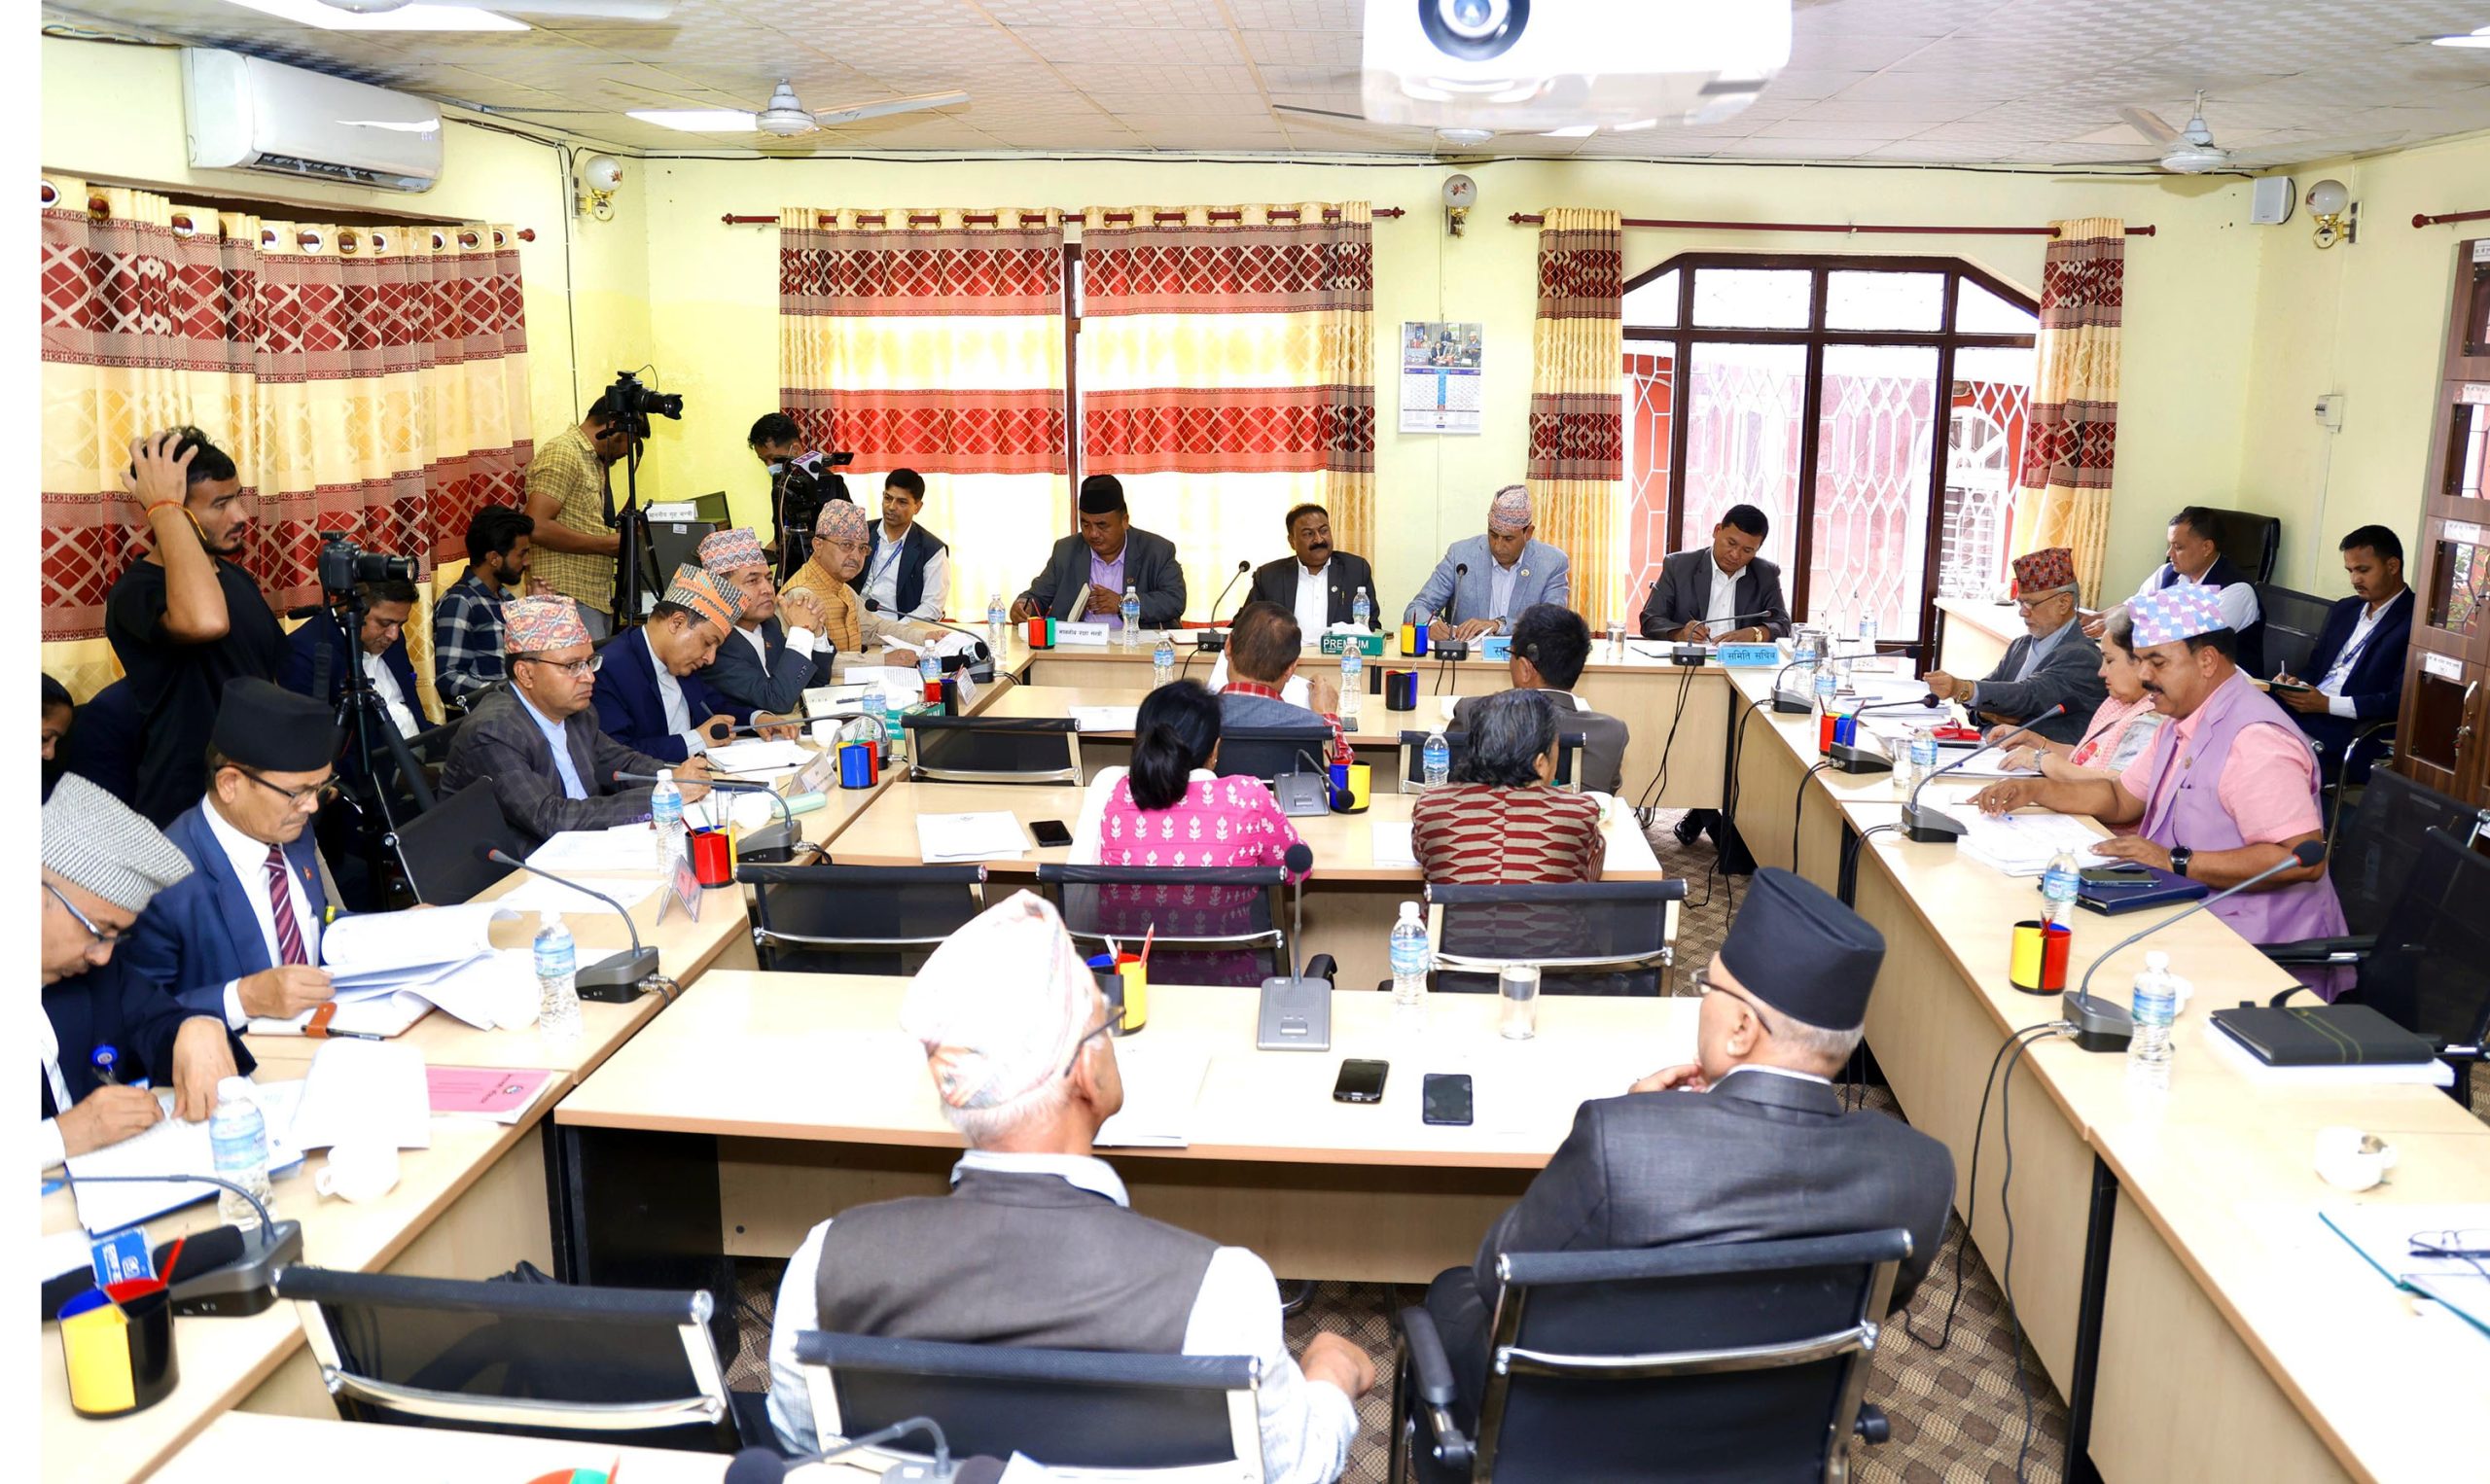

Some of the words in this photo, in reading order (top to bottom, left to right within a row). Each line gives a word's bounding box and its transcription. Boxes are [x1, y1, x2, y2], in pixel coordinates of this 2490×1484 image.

[1324, 639, 1370, 649] PREUM
[1727, 649, 1750, 660] समिति
[1755, 649, 1776, 660] सचिव
